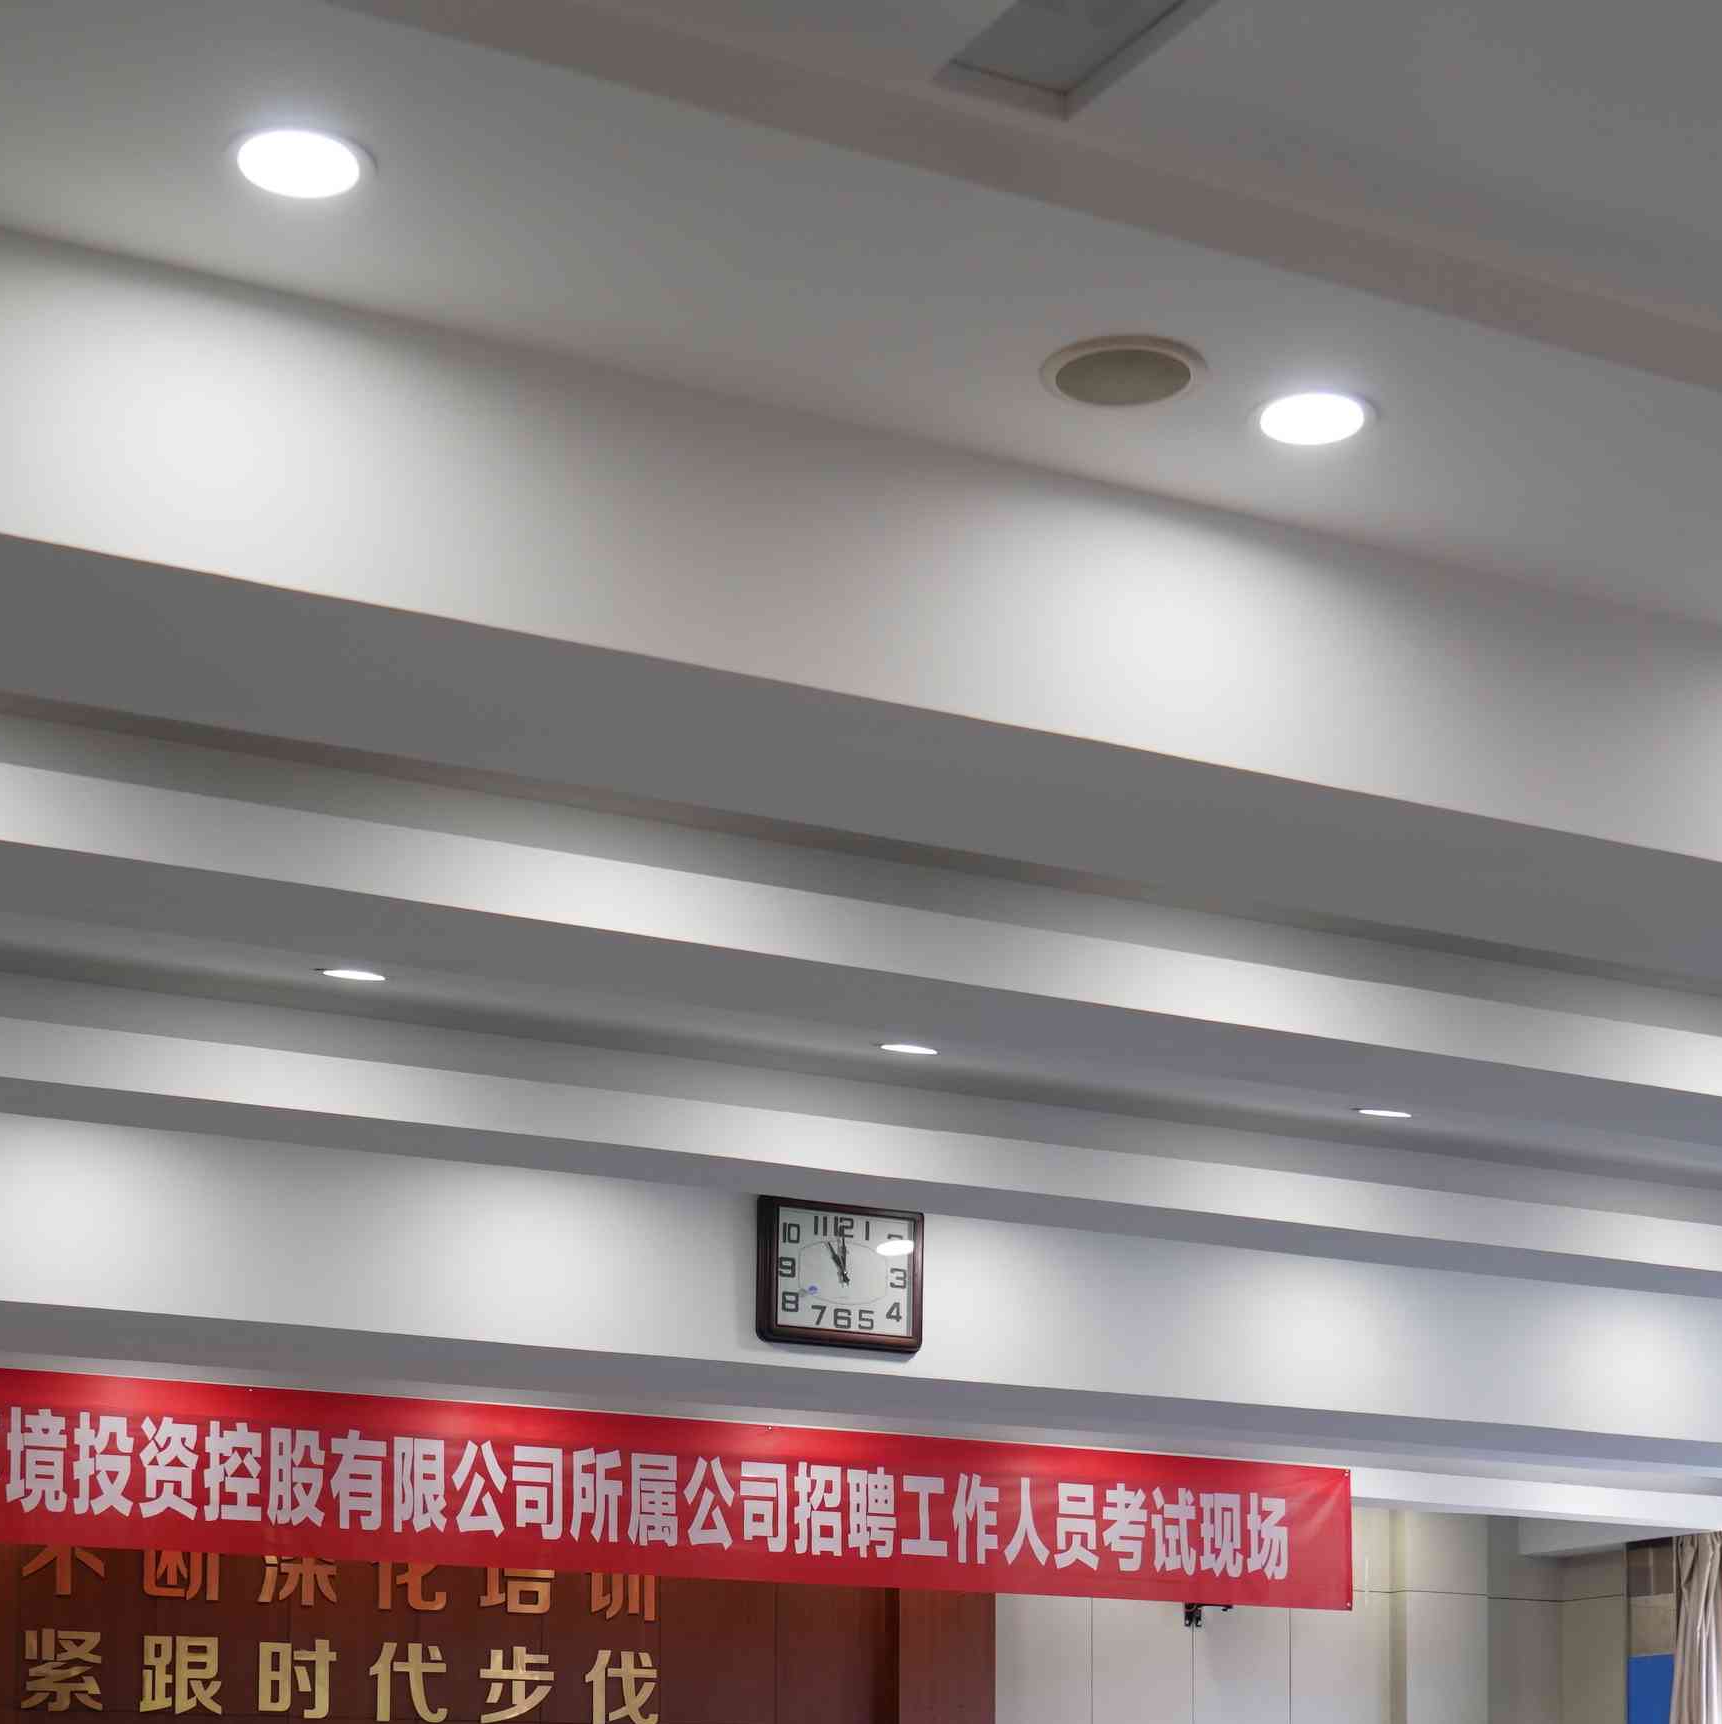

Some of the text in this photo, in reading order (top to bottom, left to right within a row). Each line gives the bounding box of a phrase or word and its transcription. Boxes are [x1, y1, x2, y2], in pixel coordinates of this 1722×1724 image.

[782, 1221, 801, 1244] 10
[778, 1256, 796, 1278] 9
[889, 1267, 907, 1290] 3
[781, 1291, 800, 1313] 8
[885, 1301, 903, 1323] 4
